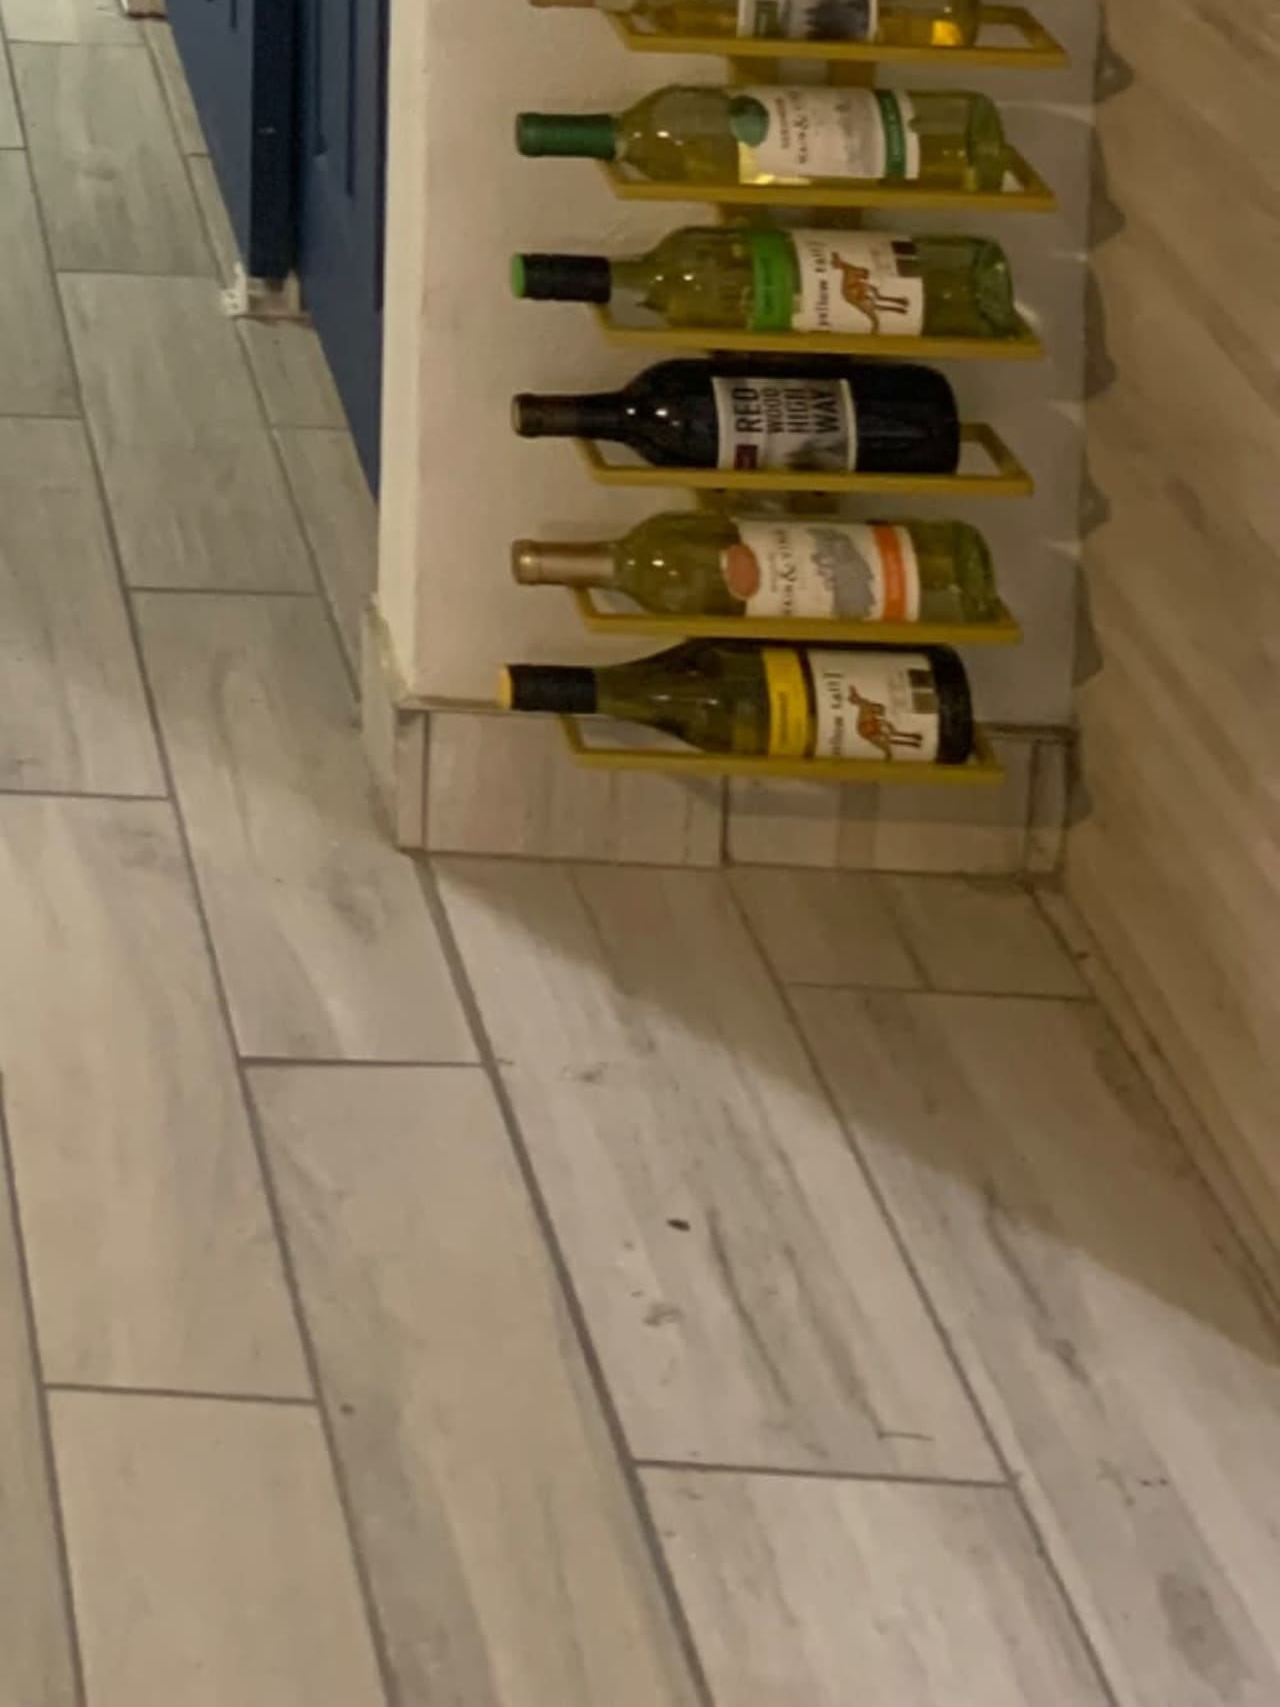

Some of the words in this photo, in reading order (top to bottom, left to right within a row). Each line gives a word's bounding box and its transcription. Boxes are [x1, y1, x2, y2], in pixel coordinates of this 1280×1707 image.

[813, 279, 831, 328] yellow
[733, 387, 763, 433] RED
[761, 387, 786, 435] WOOD
[811, 389, 839, 434] WAY
